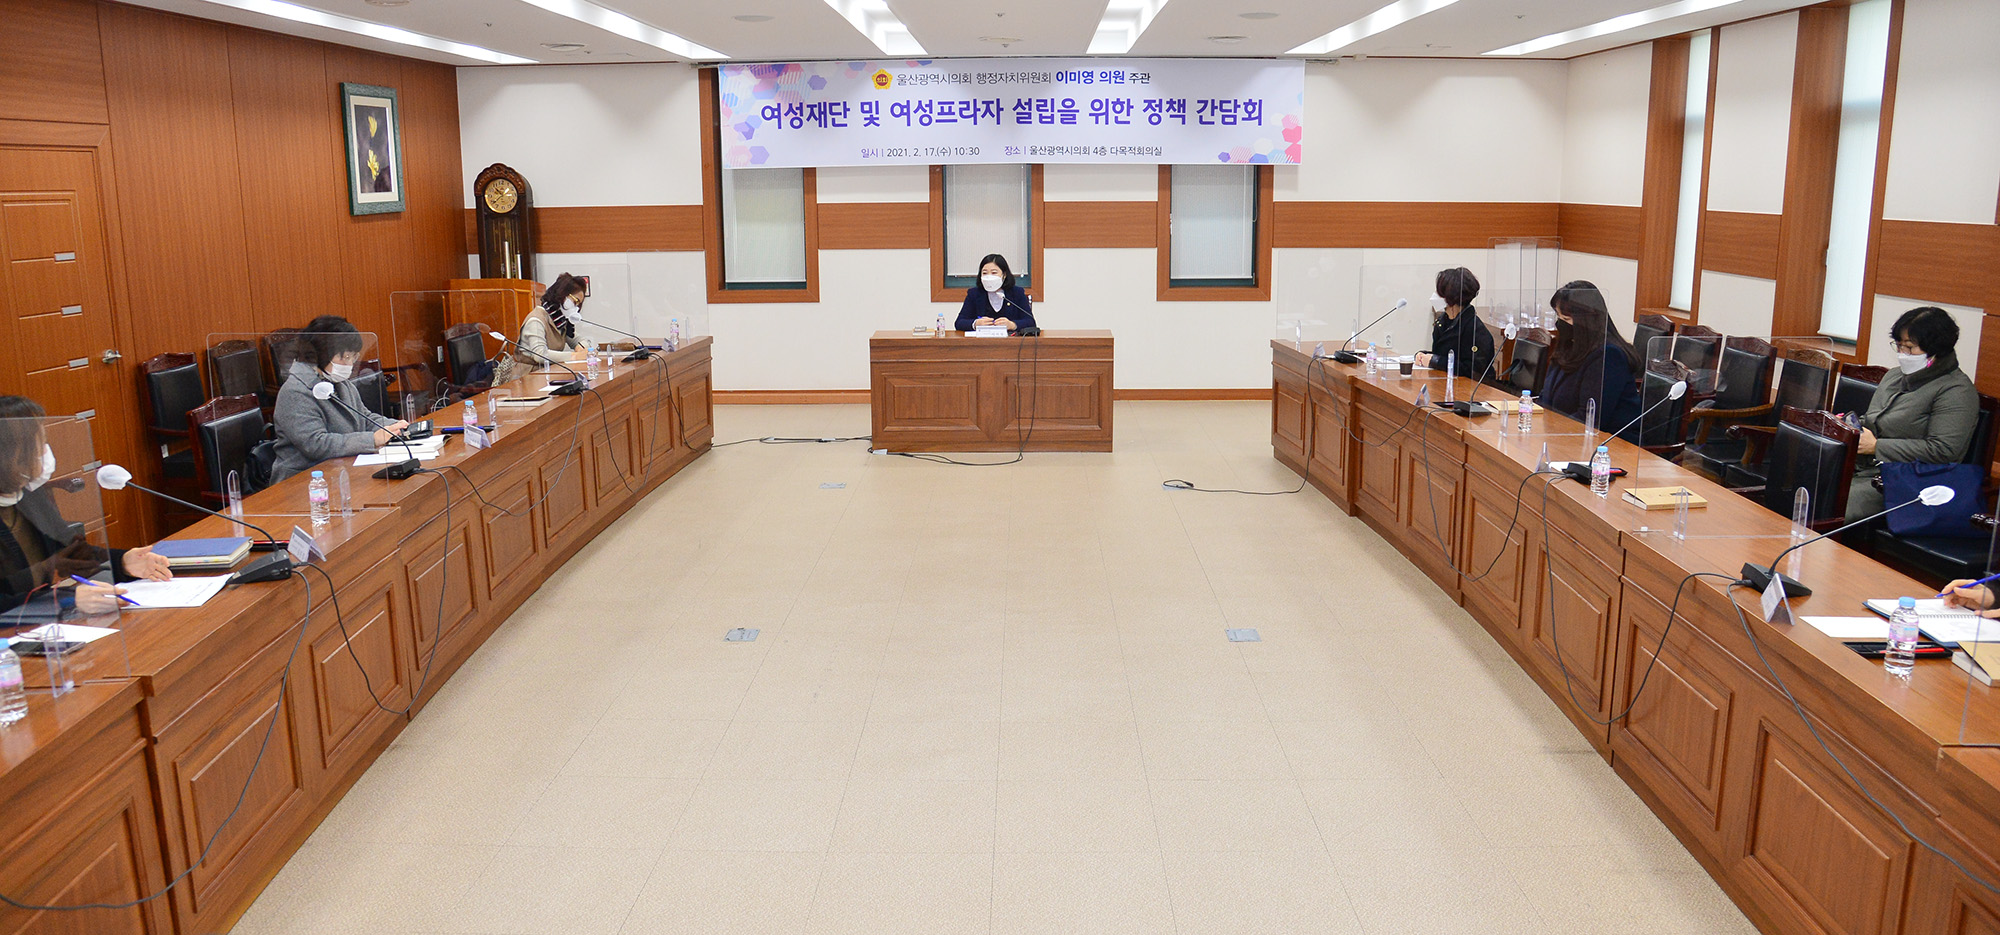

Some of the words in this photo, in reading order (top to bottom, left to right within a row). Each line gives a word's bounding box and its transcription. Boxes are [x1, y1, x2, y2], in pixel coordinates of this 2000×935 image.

[897, 72, 972, 86] 울산광역시의회
[976, 72, 1052, 84] 행정자치위원회
[1056, 70, 1094, 84] 이미영
[1099, 70, 1125, 84] 의원
[1129, 72, 1151, 84] 주관
[761, 101, 850, 129] 여성재단
[860, 100, 880, 127] 및
[890, 98, 1004, 127] 여성프라자
[1012, 98, 1080, 125] 설립을
[1088, 98, 1134, 125] 위한
[1142, 98, 1187, 125] 정책
[1196, 98, 1263, 126] 간담회
[861, 148, 879, 158] 일시
[887, 148, 911, 157] 2021.
[955, 147, 980, 156] 10:30
[1004, 146, 1021, 155] 장소
[1029, 146, 1090, 156] 울산광역시의회
[1092, 146, 1107, 156] 4층
[1110, 146, 1162, 156] 다목적회의실
